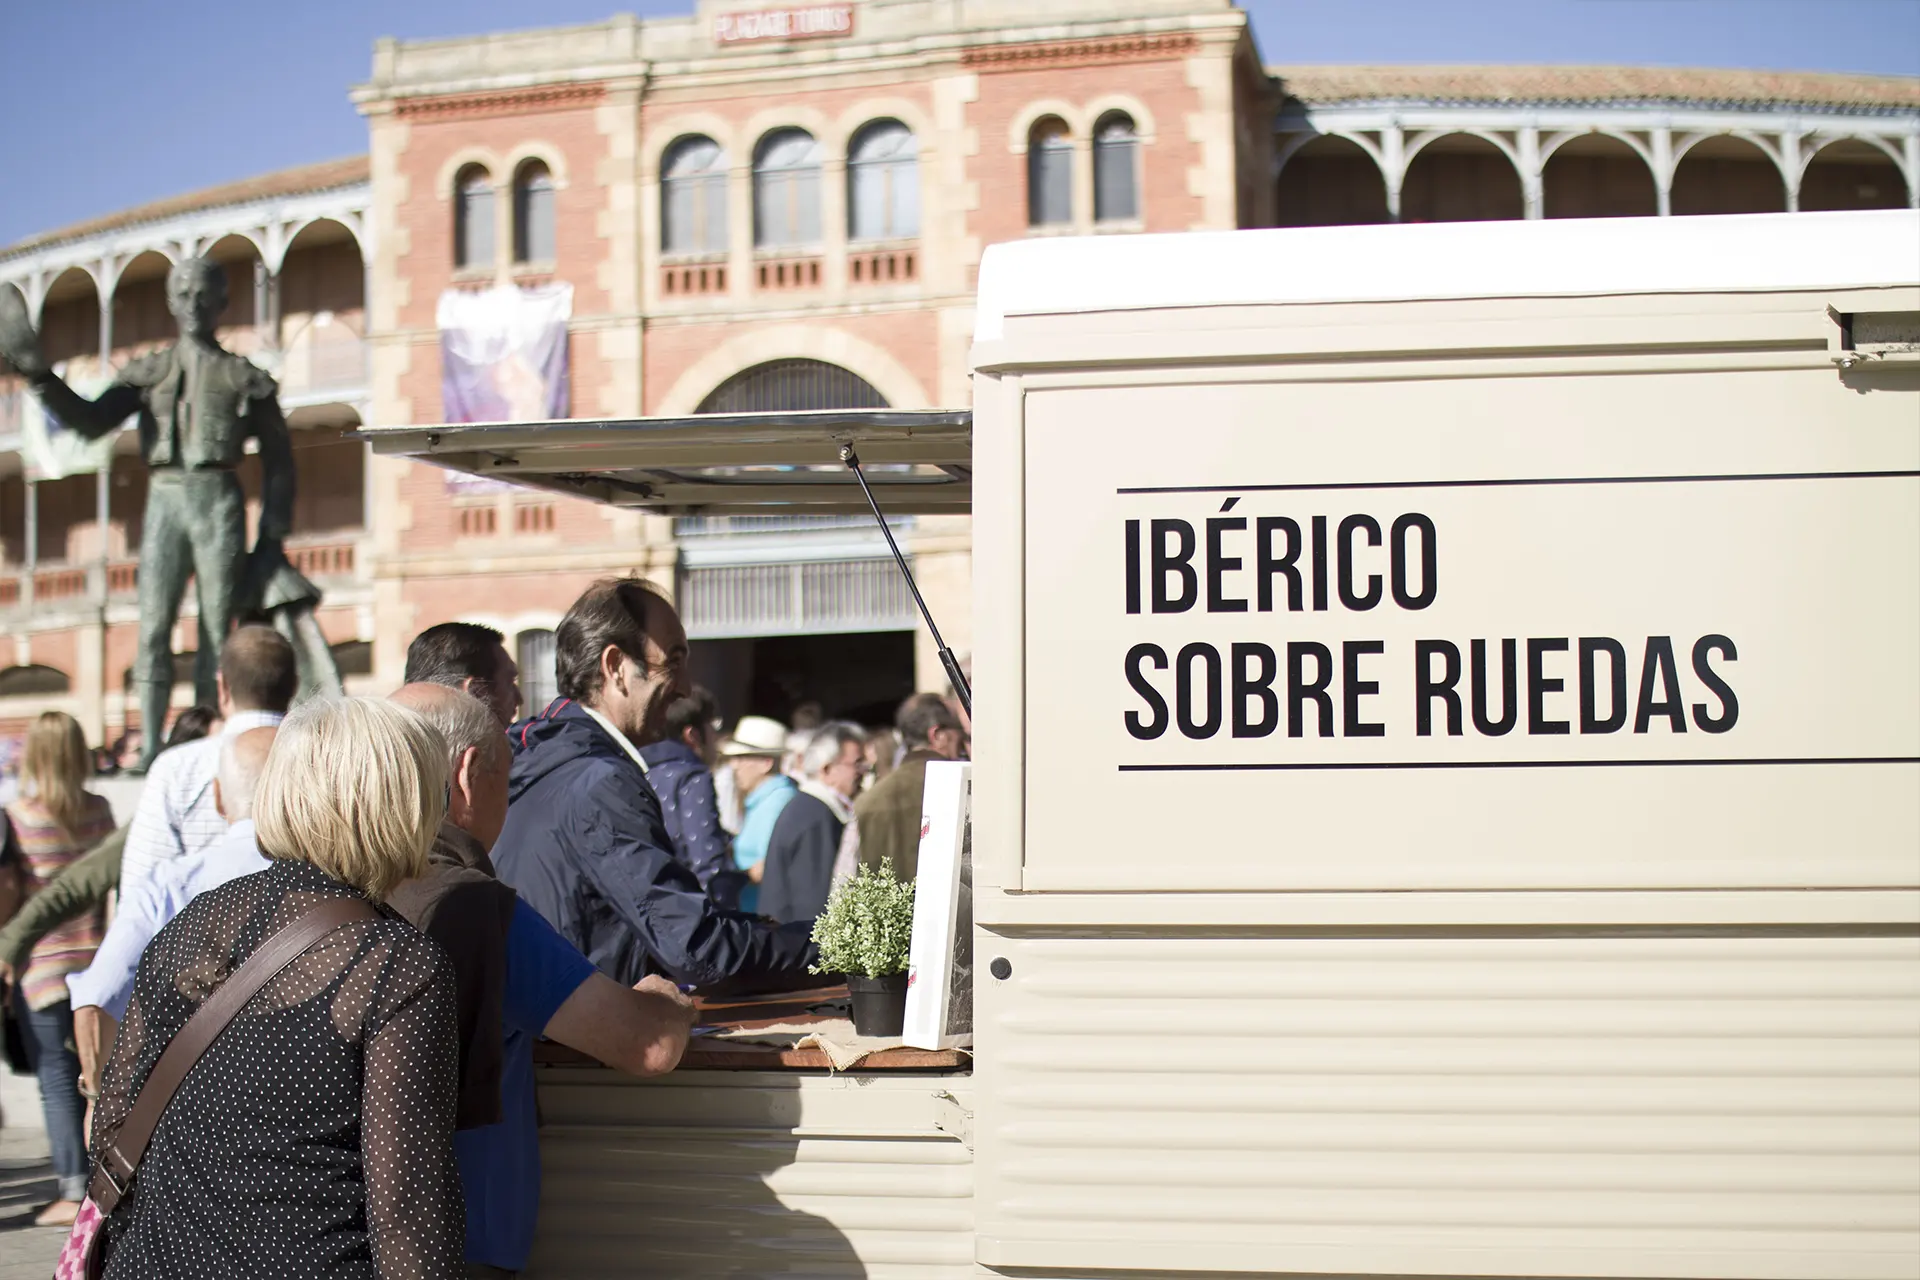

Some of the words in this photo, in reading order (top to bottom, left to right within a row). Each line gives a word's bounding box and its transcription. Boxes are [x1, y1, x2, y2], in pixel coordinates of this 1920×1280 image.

[1125, 496, 1437, 615] IBÉRICO
[1124, 640, 1385, 741] SOBRE
[1415, 634, 1739, 737] RUEDAS
